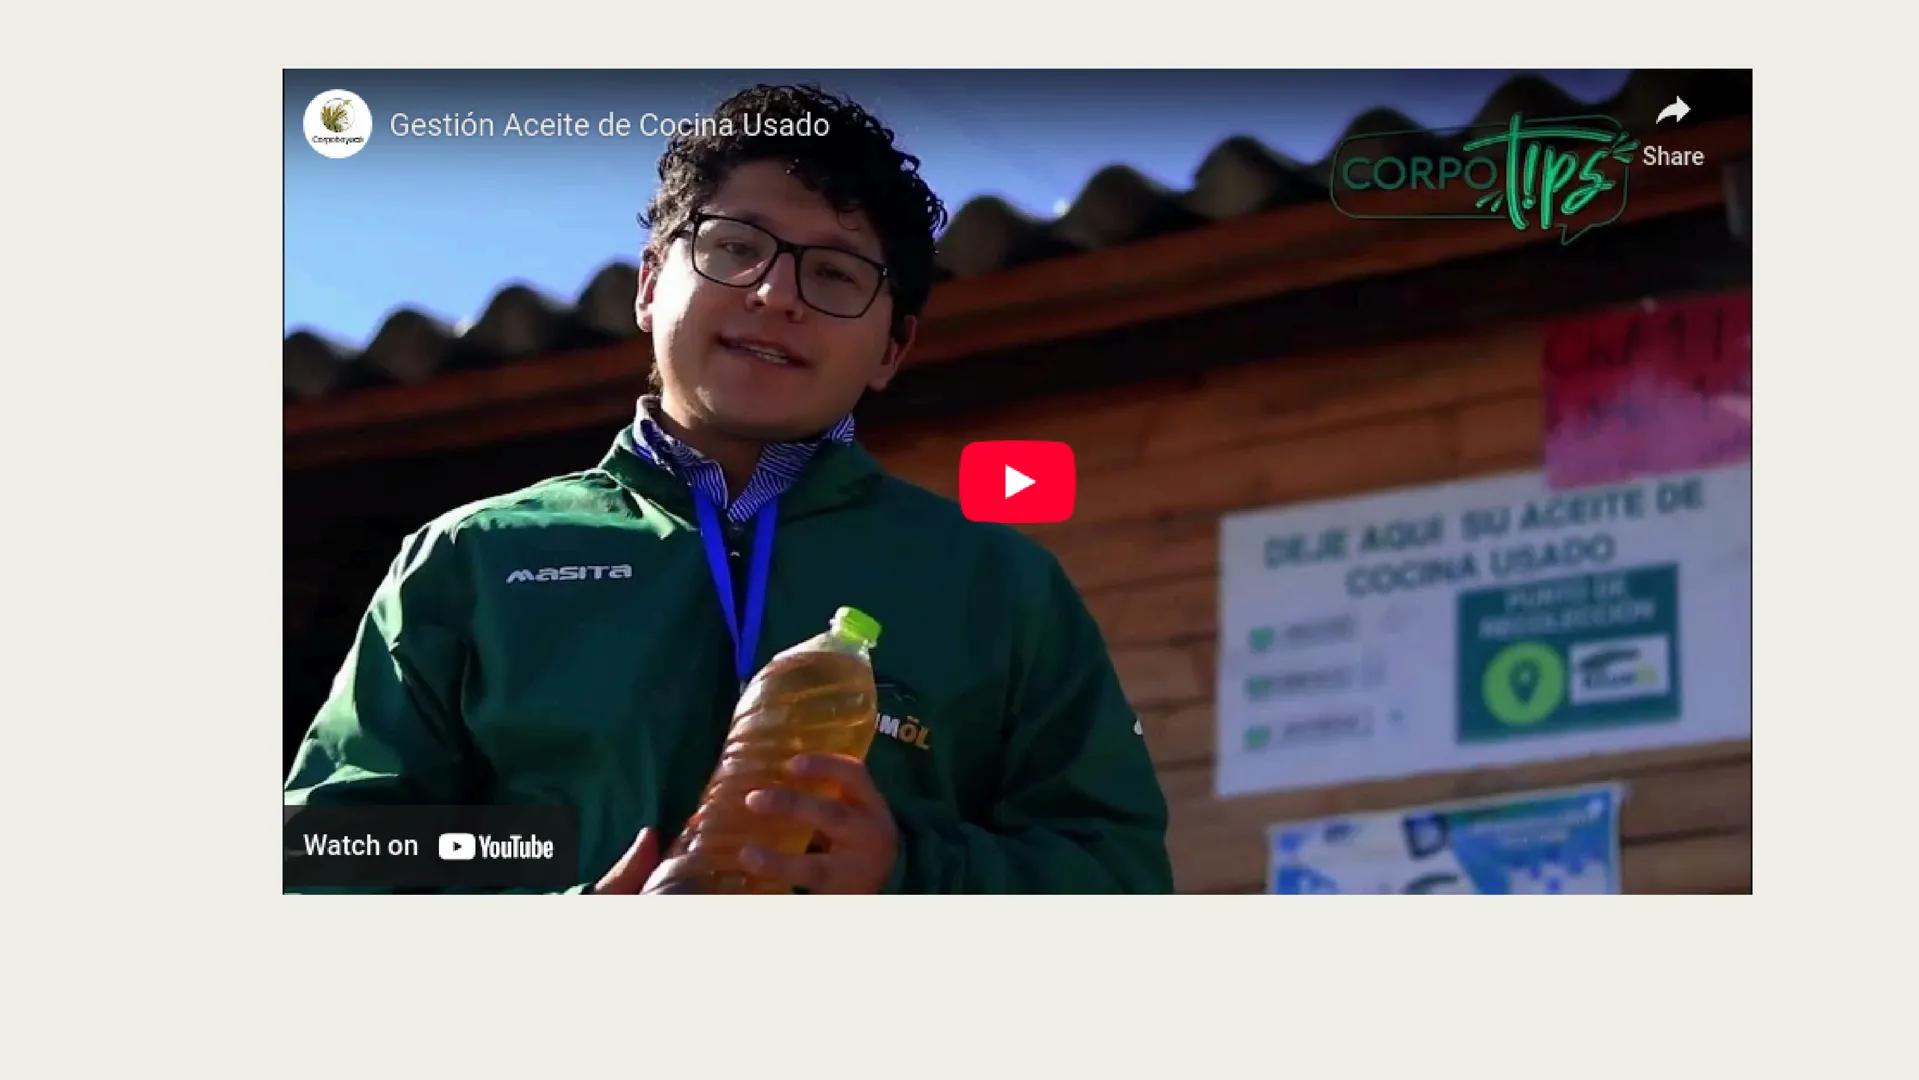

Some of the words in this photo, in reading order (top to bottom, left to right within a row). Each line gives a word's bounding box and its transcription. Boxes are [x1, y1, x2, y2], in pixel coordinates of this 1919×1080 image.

[1264, 527, 1350, 568] DEJE
[1460, 507, 1512, 542] SU
[1518, 491, 1645, 532] ACEITE
[1656, 479, 1705, 514] DE
[1346, 553, 1478, 597] COCINA
[1488, 534, 1617, 575] USADO
